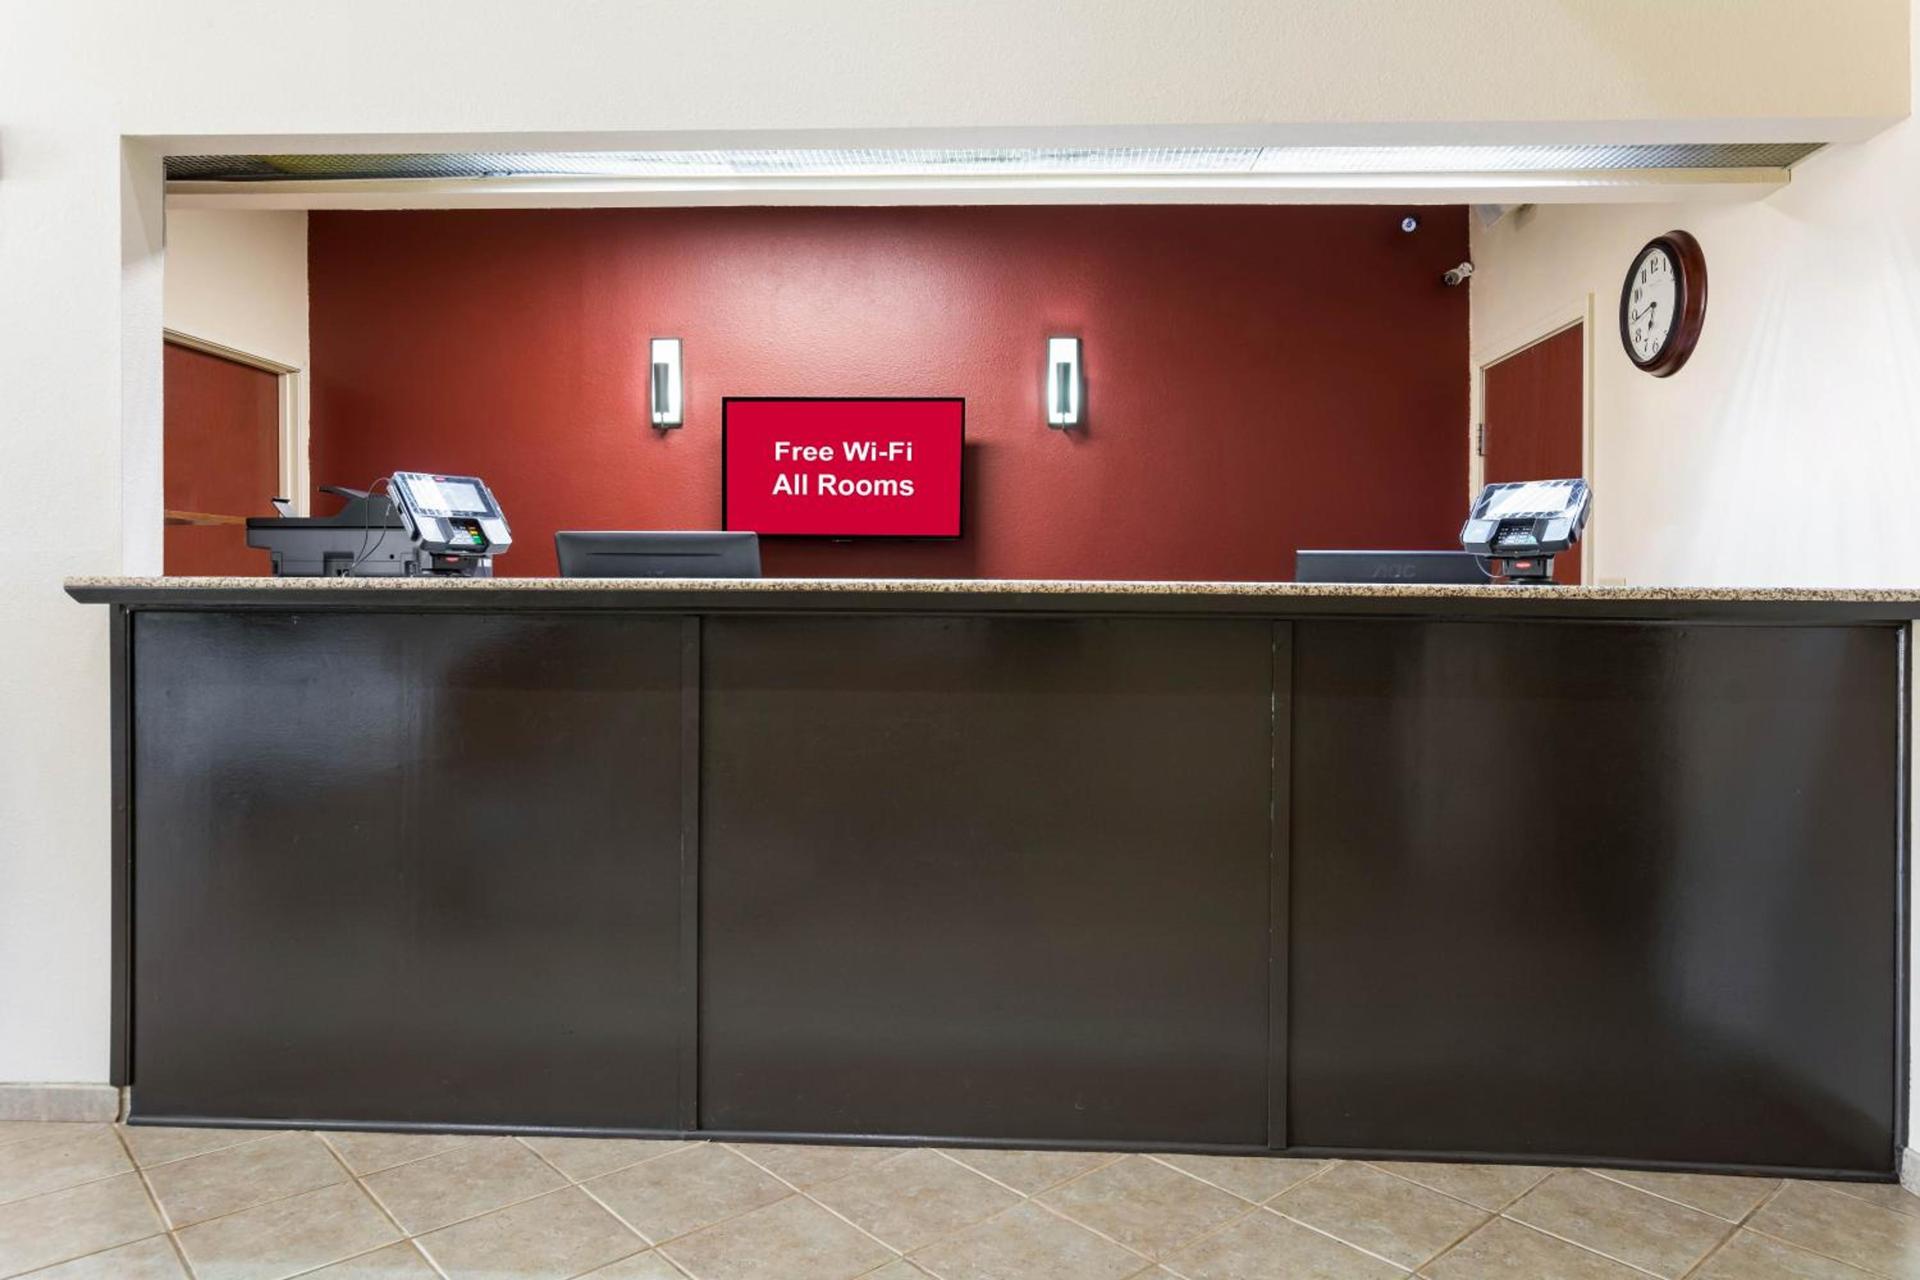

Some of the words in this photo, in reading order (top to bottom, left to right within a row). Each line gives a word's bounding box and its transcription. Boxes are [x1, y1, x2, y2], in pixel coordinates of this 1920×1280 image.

[1650, 256, 1658, 274] 12
[1641, 268, 1647, 284] 11
[1635, 328, 1642, 343] 8
[1652, 337, 1659, 353] 6
[774, 441, 833, 461] Free
[843, 441, 912, 461] Wi-Fi
[772, 473, 808, 496] All
[818, 473, 914, 496] Rooms
[1371, 562, 1417, 578] AOC
